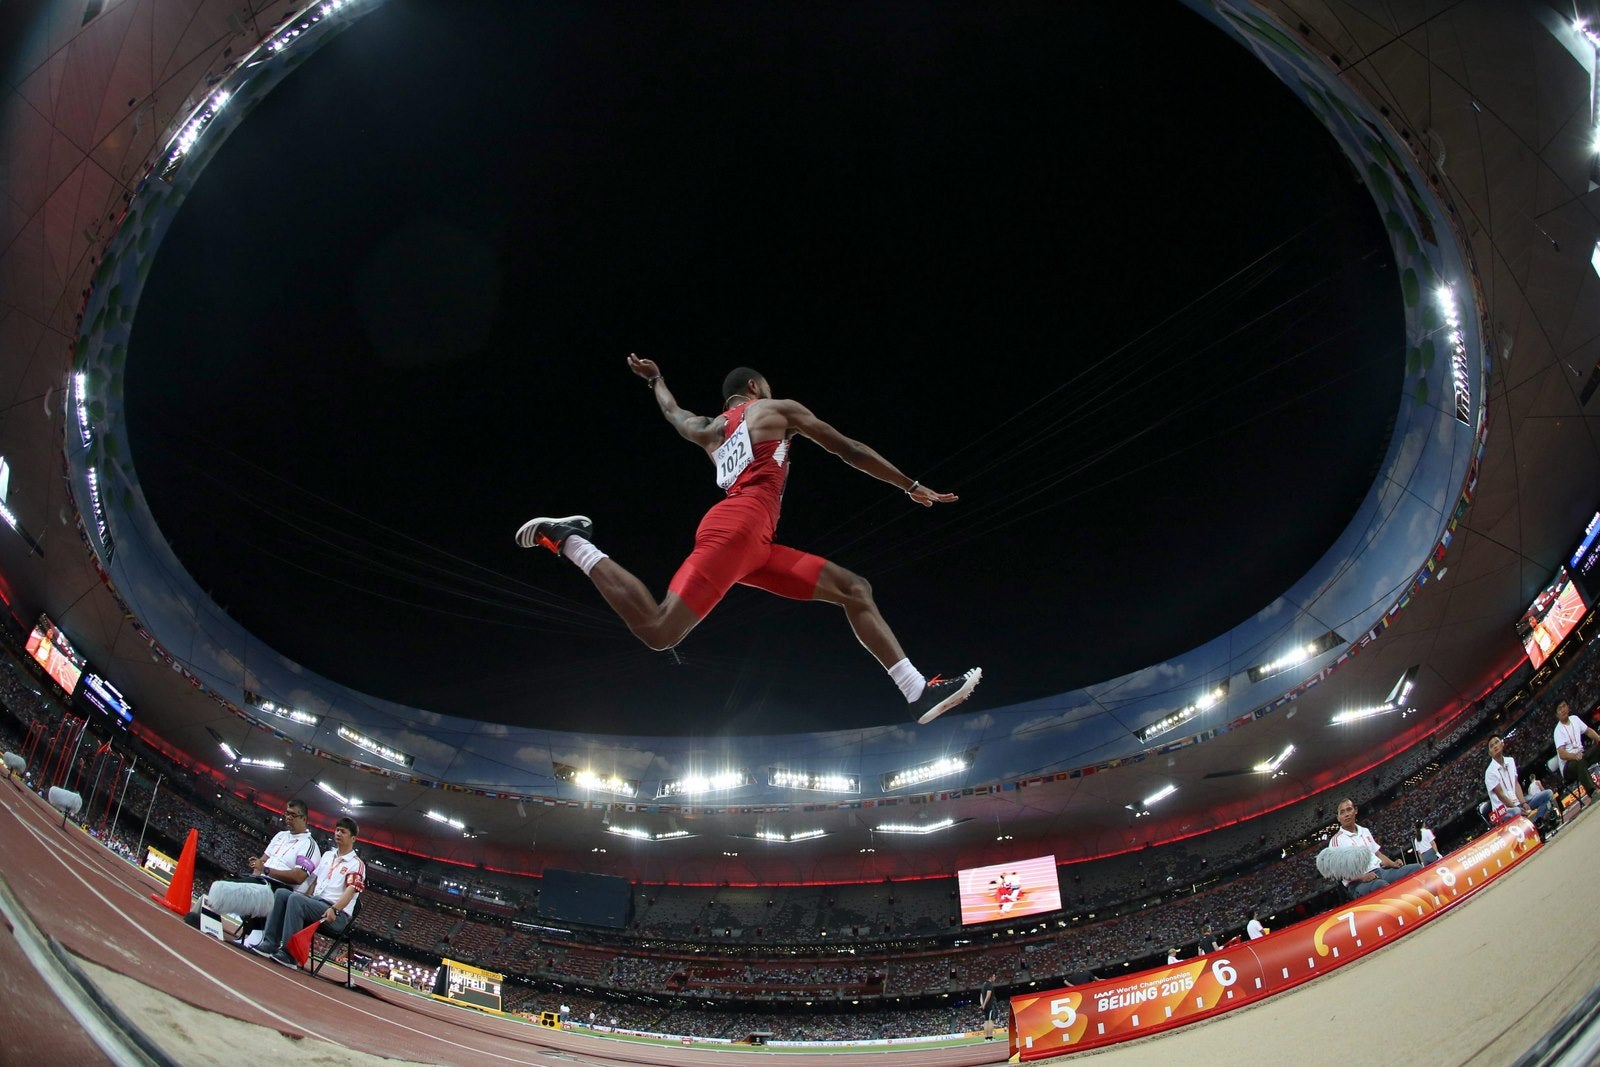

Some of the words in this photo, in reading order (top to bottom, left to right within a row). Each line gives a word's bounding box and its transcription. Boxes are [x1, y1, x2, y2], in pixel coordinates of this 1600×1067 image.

[721, 441, 746, 477] 1072
[1509, 825, 1525, 843] 9
[1436, 867, 1456, 887] 8
[1337, 912, 1357, 938] 7
[1094, 990, 1114, 999] IAAF
[1116, 985, 1138, 994] World
[1139, 971, 1191, 988] Championships
[1212, 959, 1238, 987] 6
[1098, 987, 1157, 1012] BEIJING
[1161, 977, 1194, 997] 2015
[1050, 998, 1077, 1028] 5
